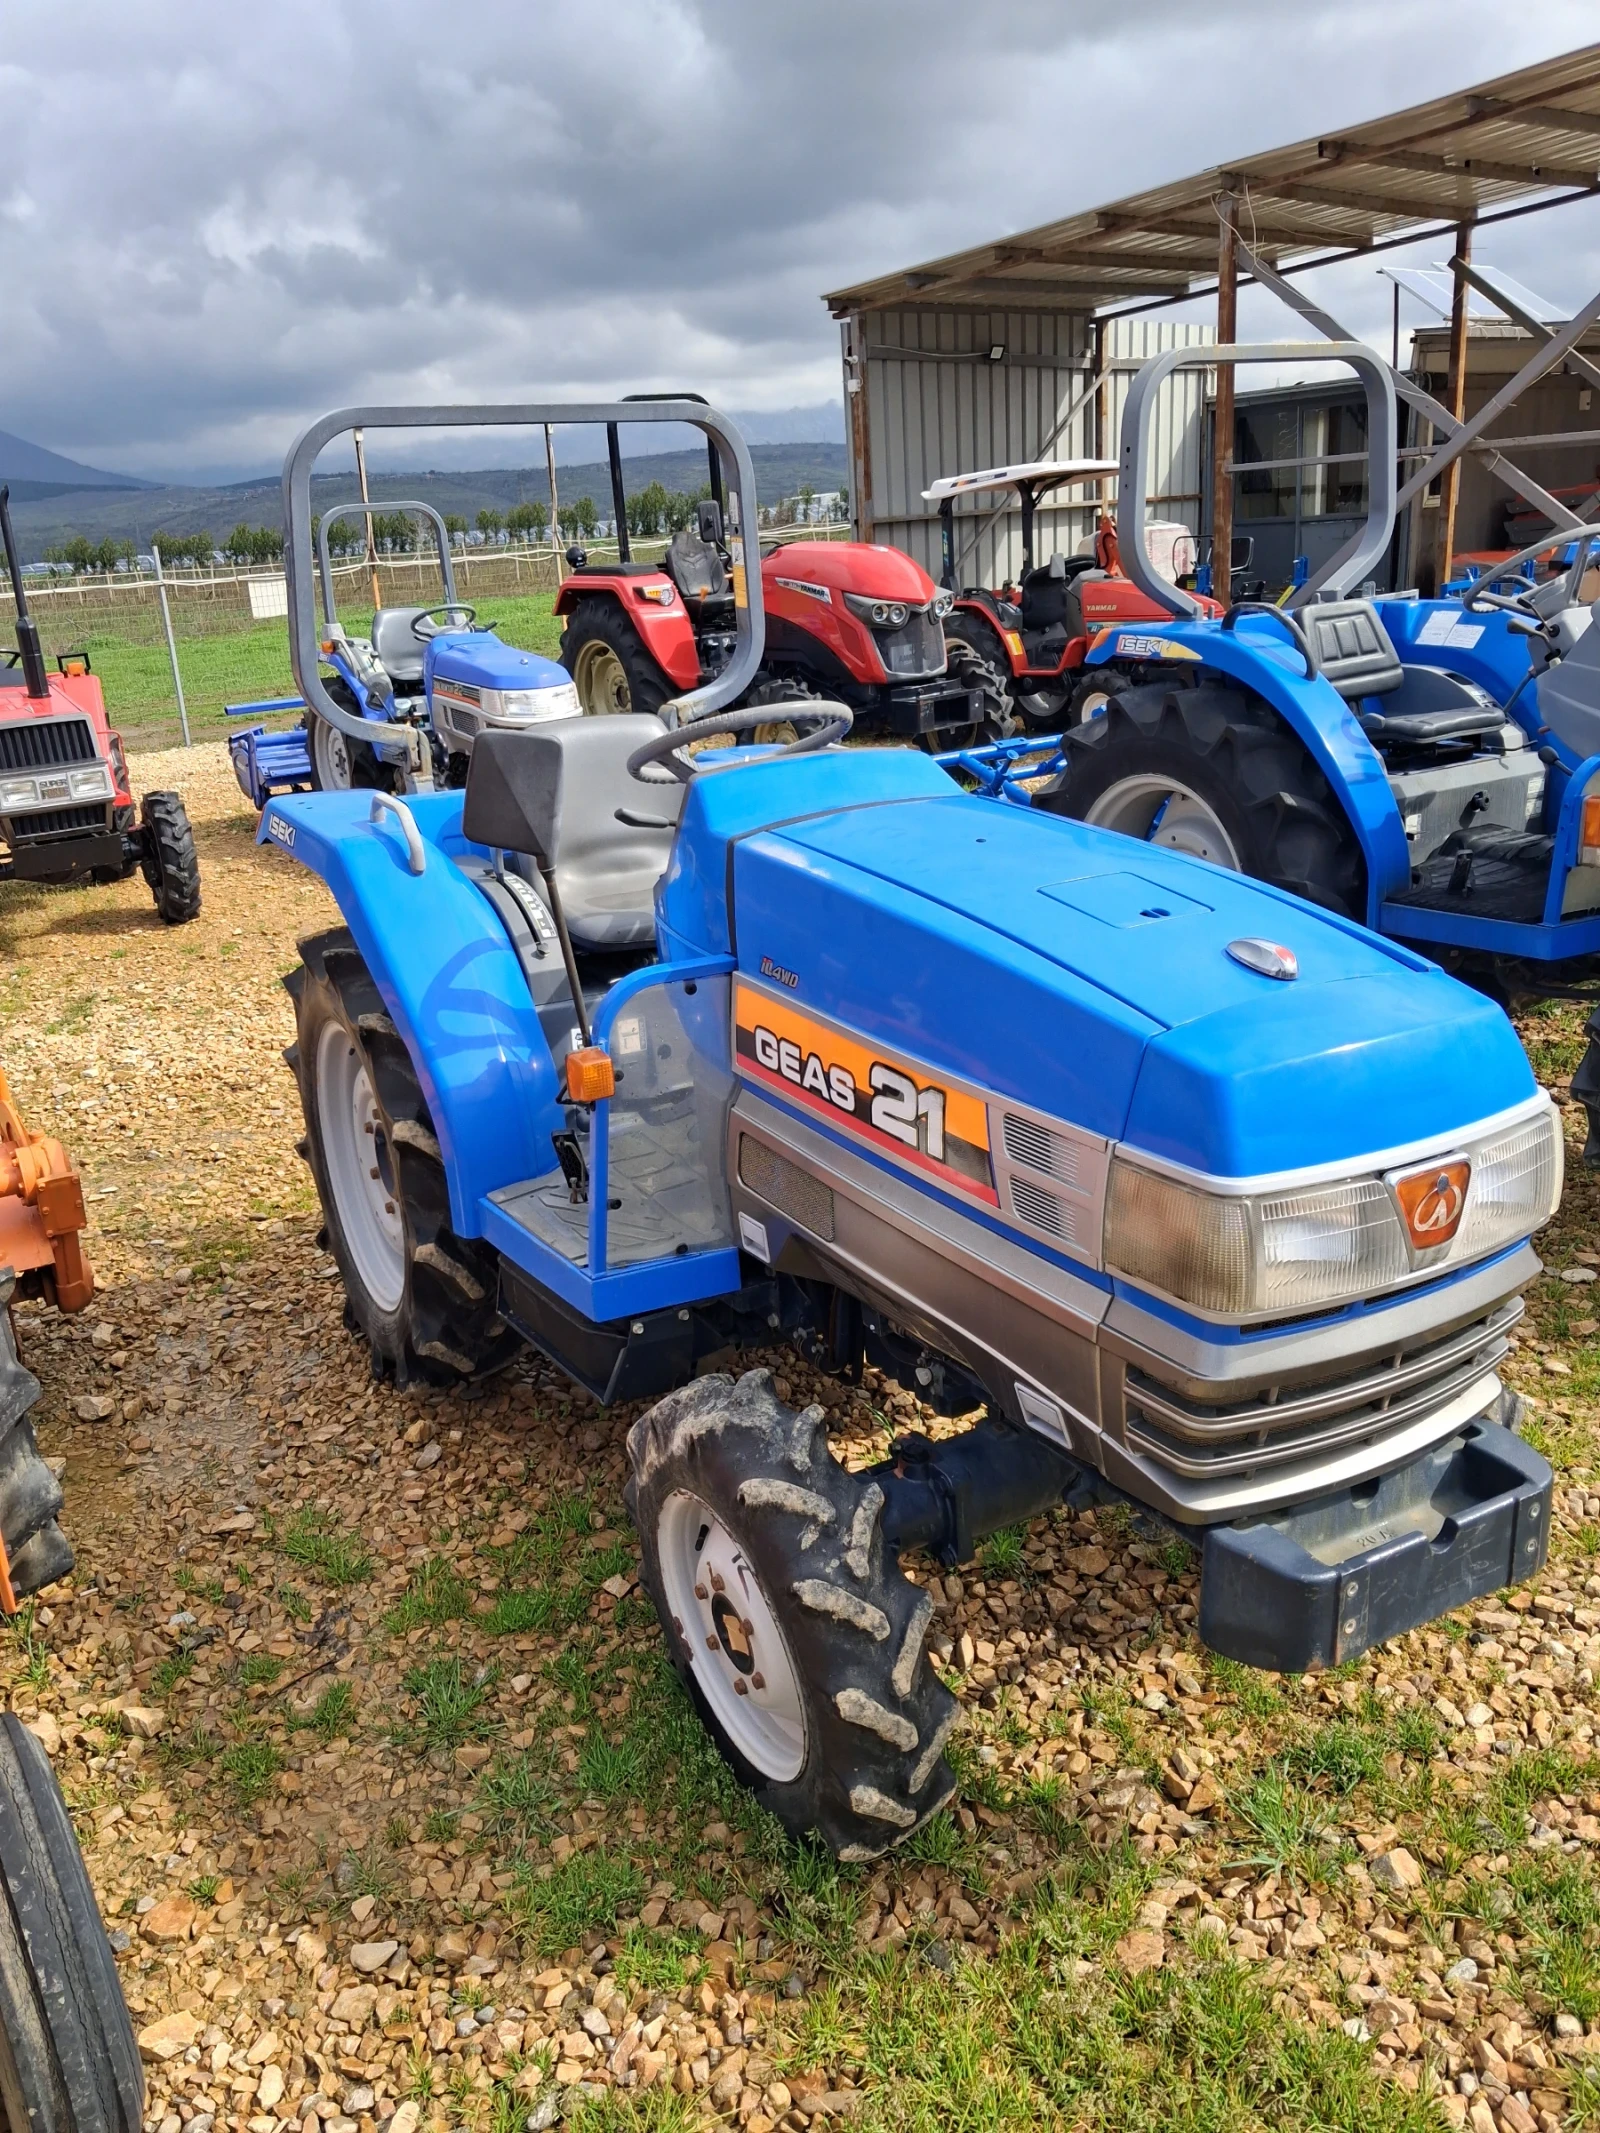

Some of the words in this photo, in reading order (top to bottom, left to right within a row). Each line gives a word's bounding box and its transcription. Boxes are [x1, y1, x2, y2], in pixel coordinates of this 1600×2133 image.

[800, 584, 826, 597] YANMAR
[1086, 604, 1118, 612] YANMAR
[1120, 638, 1162, 653] ISEKI
[39, 779, 68, 788] SUPER
[268, 812, 297, 849] ISEKI
[754, 1025, 856, 1112] GEAS
[869, 1061, 946, 1163] 21
